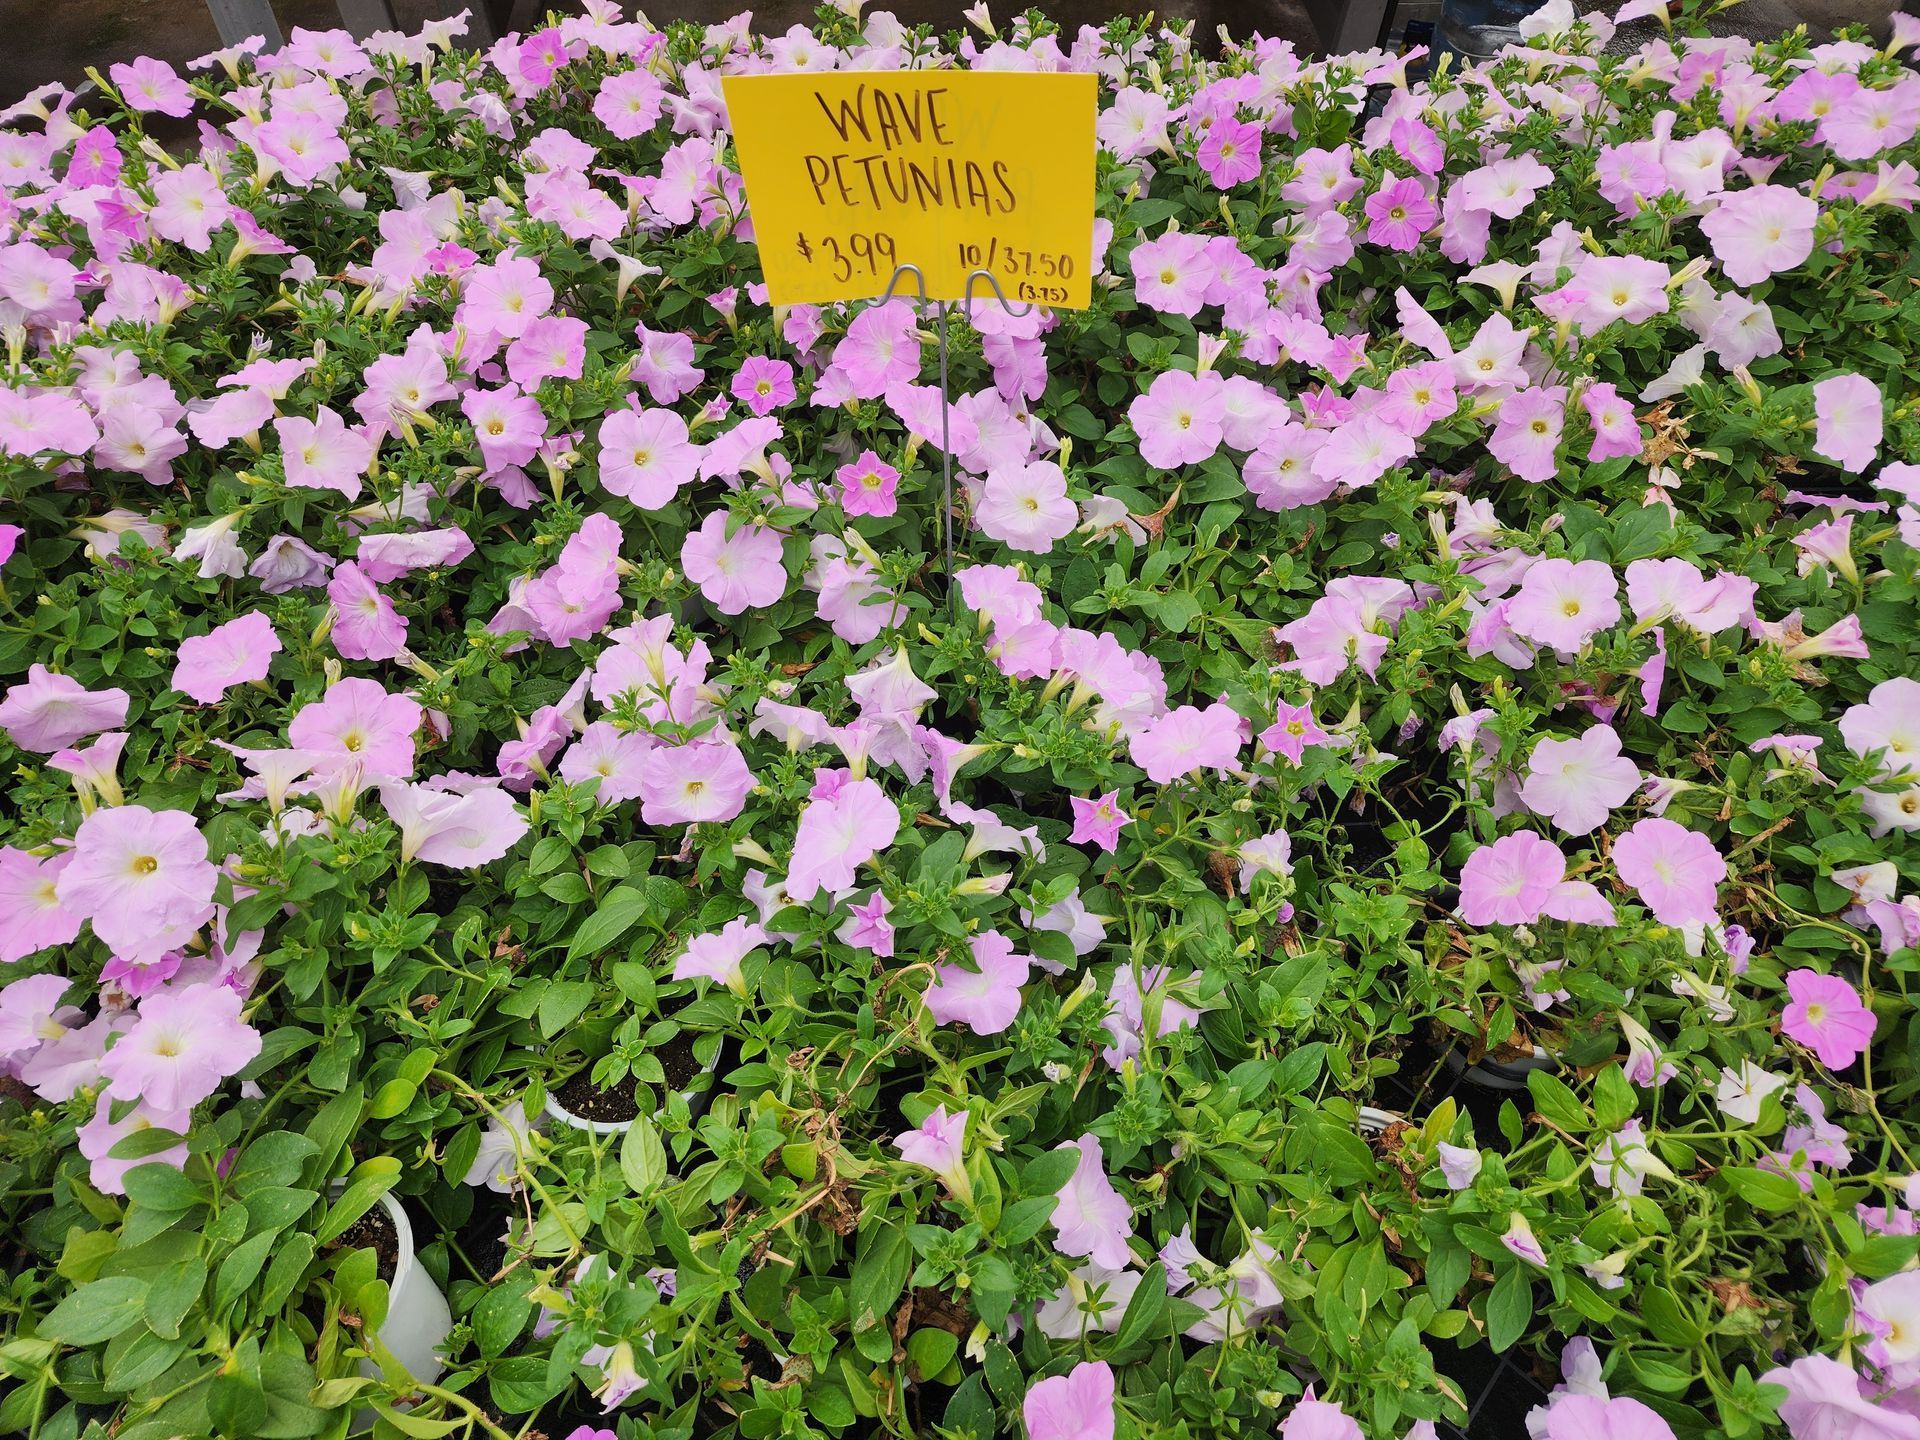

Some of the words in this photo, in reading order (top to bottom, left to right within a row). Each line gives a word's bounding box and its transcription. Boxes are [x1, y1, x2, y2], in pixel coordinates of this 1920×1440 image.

[813, 83, 954, 151] WAVE
[803, 153, 1017, 216] PETUNIAS
[795, 231, 898, 283] $3.99
[958, 236, 1075, 280] 10/37.50
[1018, 280, 1069, 304] (3.75)
